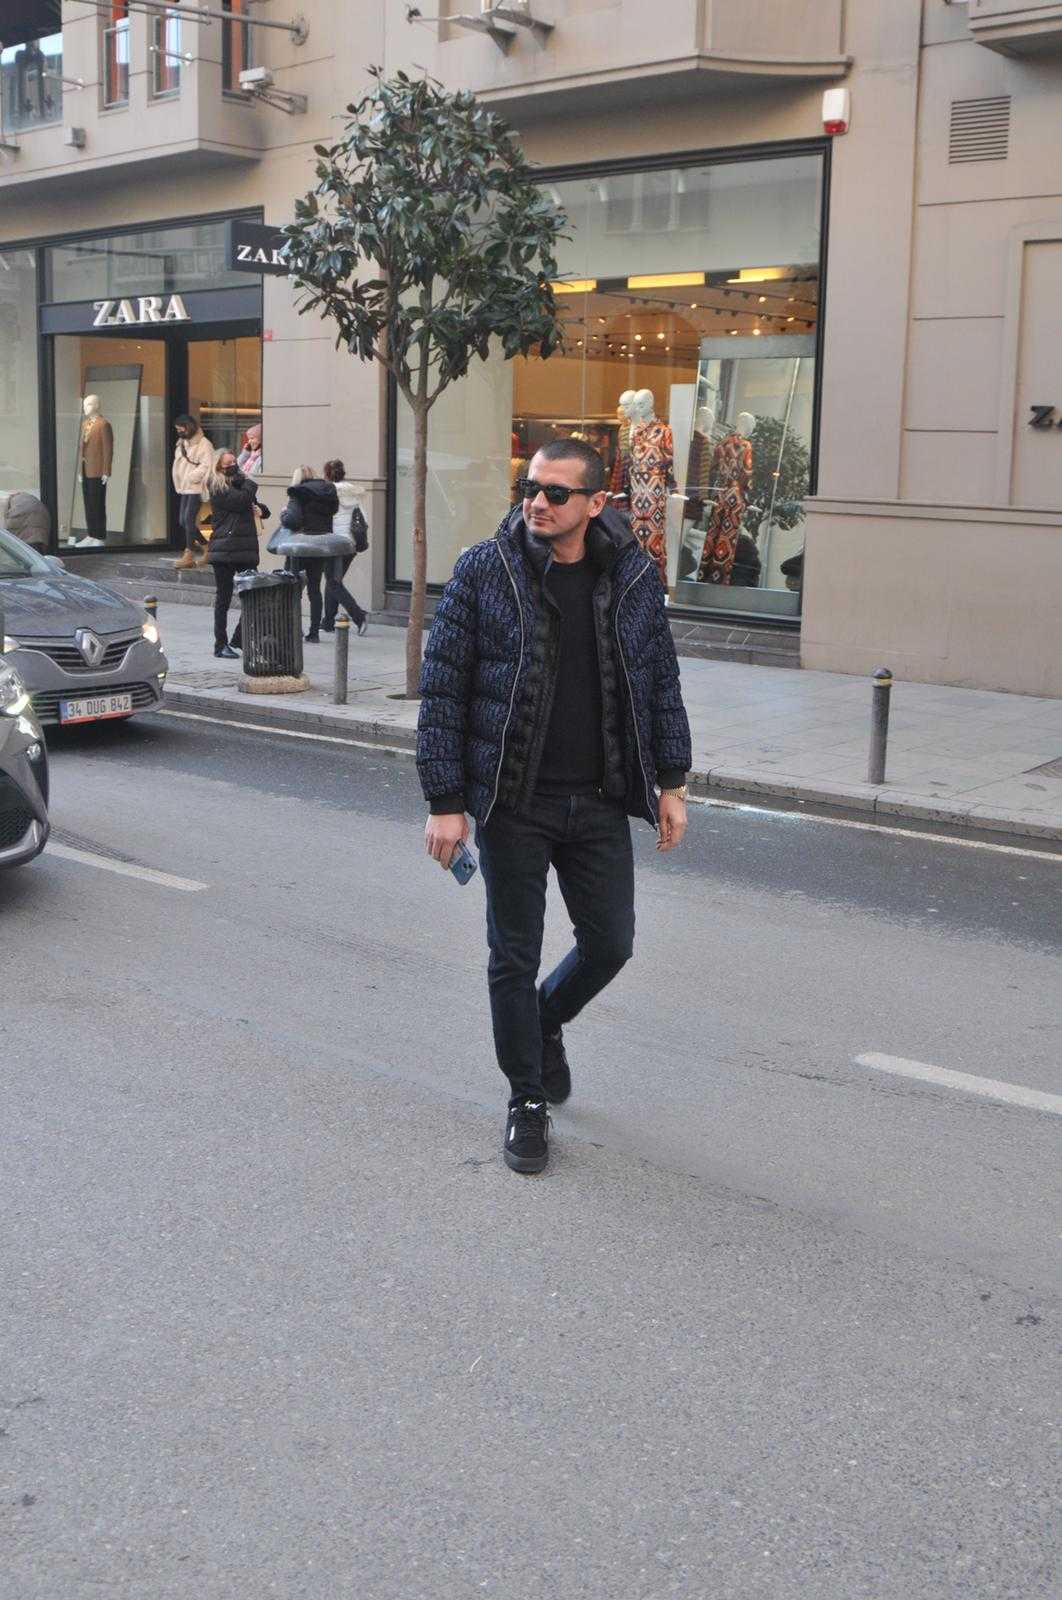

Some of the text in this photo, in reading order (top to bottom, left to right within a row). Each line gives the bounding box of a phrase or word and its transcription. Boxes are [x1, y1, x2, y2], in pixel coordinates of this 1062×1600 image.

[93, 294, 191, 327] ZARA
[1028, 405, 1062, 430] Z
[68, 702, 82, 717] 34
[110, 696, 129, 711] 842
